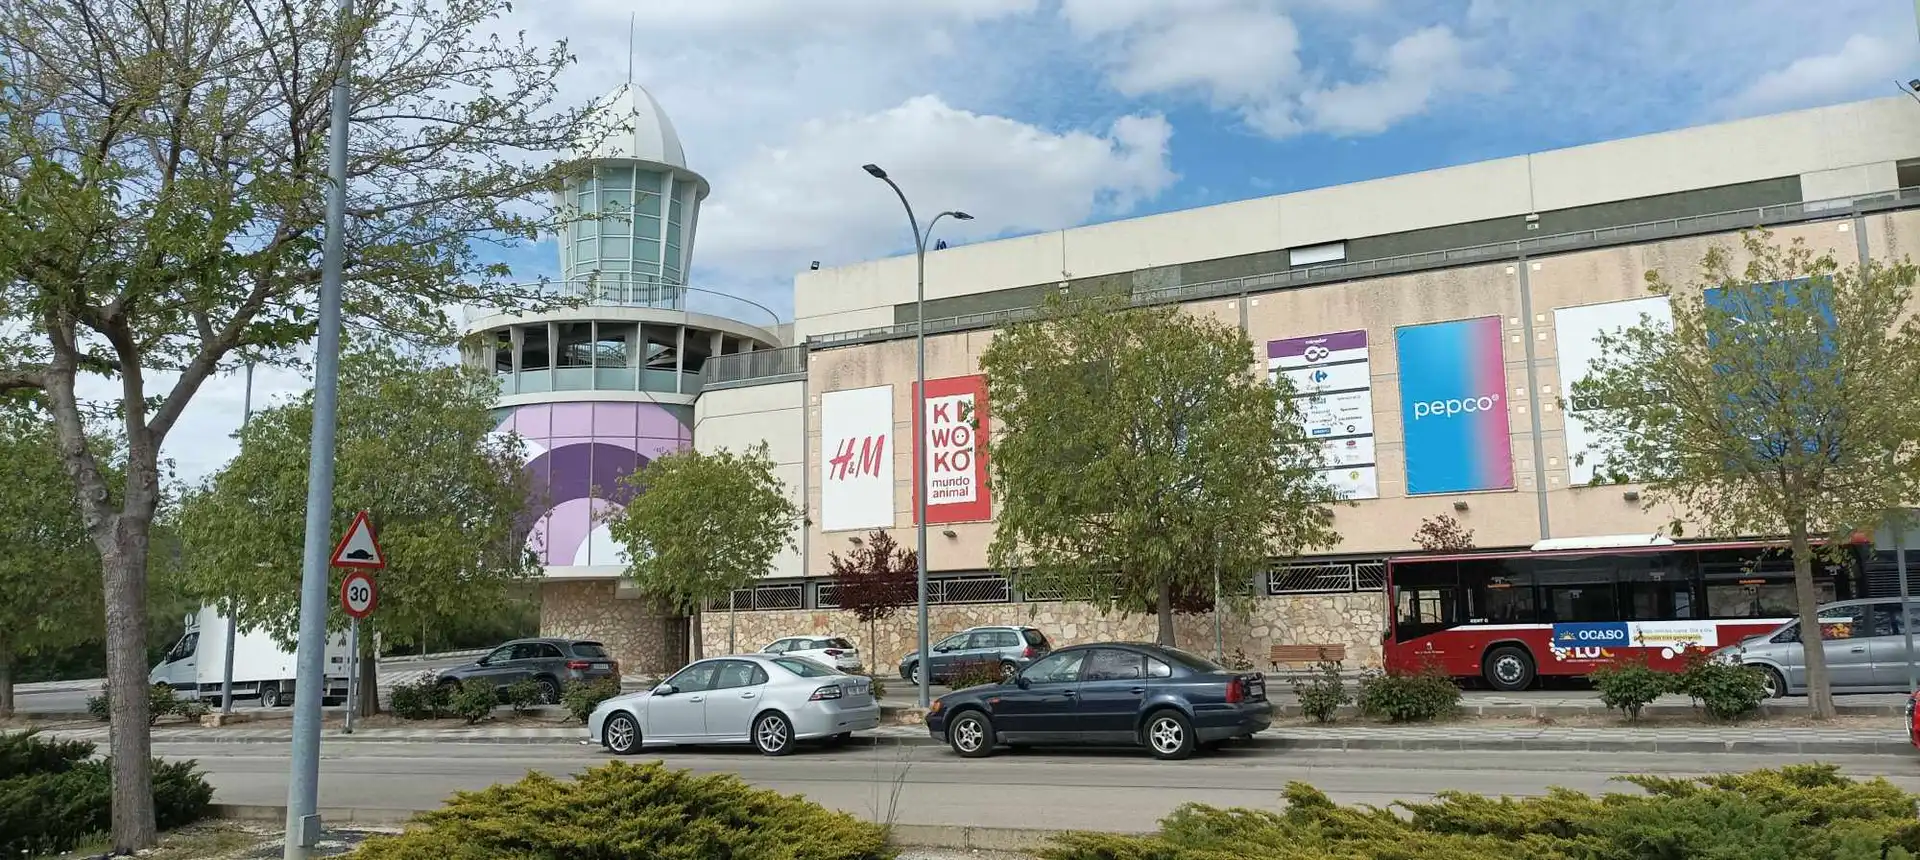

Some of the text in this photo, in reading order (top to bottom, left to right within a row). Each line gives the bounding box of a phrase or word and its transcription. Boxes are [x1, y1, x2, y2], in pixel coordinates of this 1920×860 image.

[829, 434, 885, 481] H&M
[932, 476, 970, 488] mundo
[932, 486, 969, 498] animal
[350, 586, 369, 603] 30
[1578, 629, 1625, 640] OCASO
